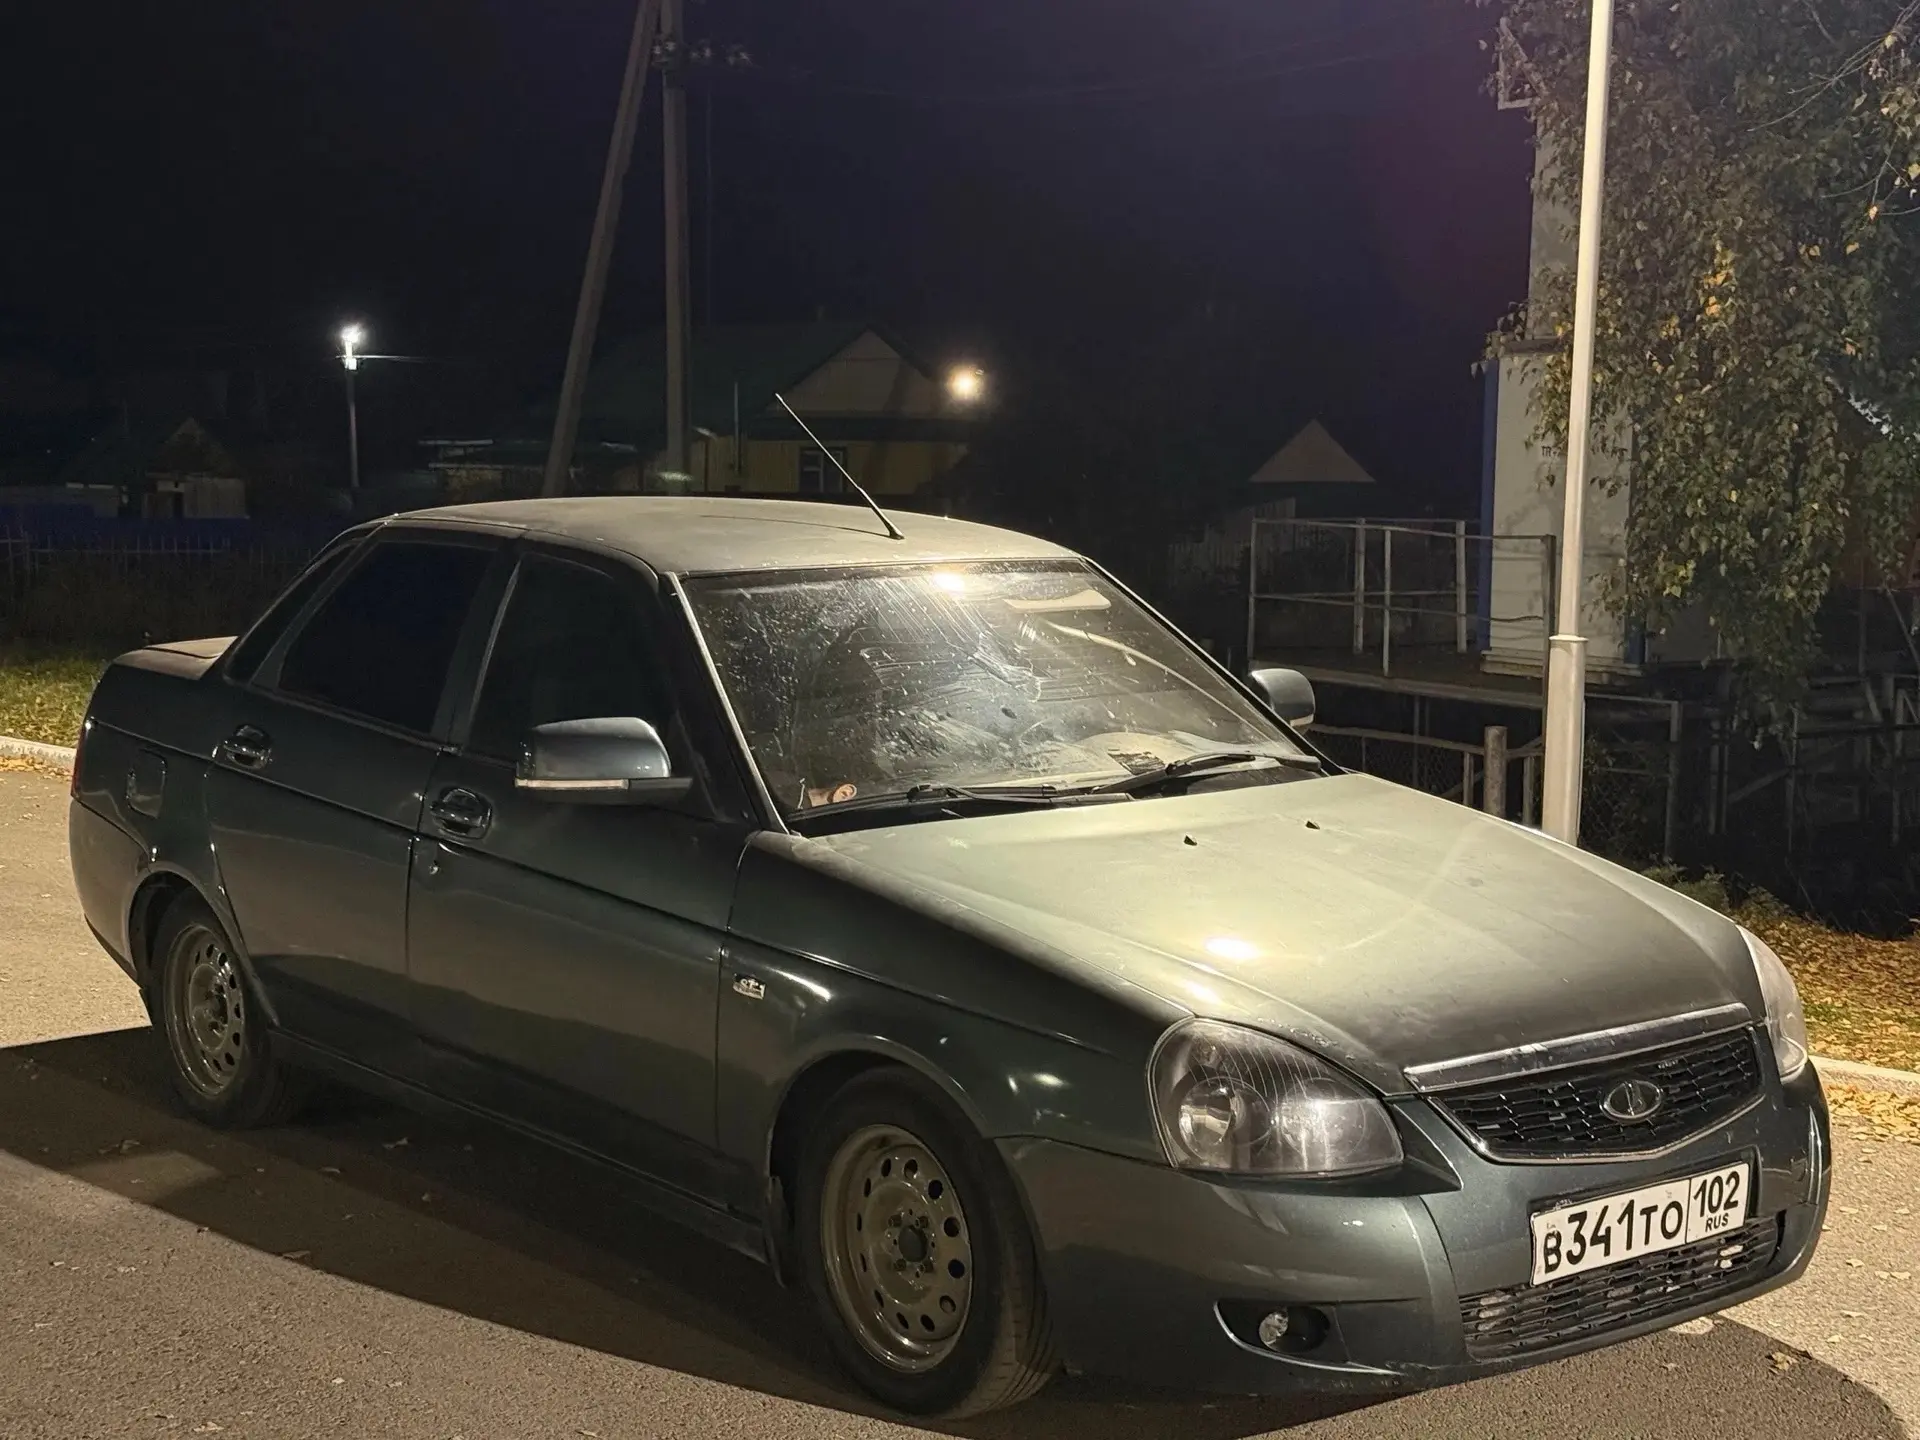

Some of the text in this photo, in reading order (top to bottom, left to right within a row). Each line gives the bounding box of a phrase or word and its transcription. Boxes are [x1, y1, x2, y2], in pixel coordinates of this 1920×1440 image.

[1693, 1170, 1741, 1218] 102
[1543, 1199, 1684, 1275] В341ТО
[1705, 1212, 1730, 1233] RUS
